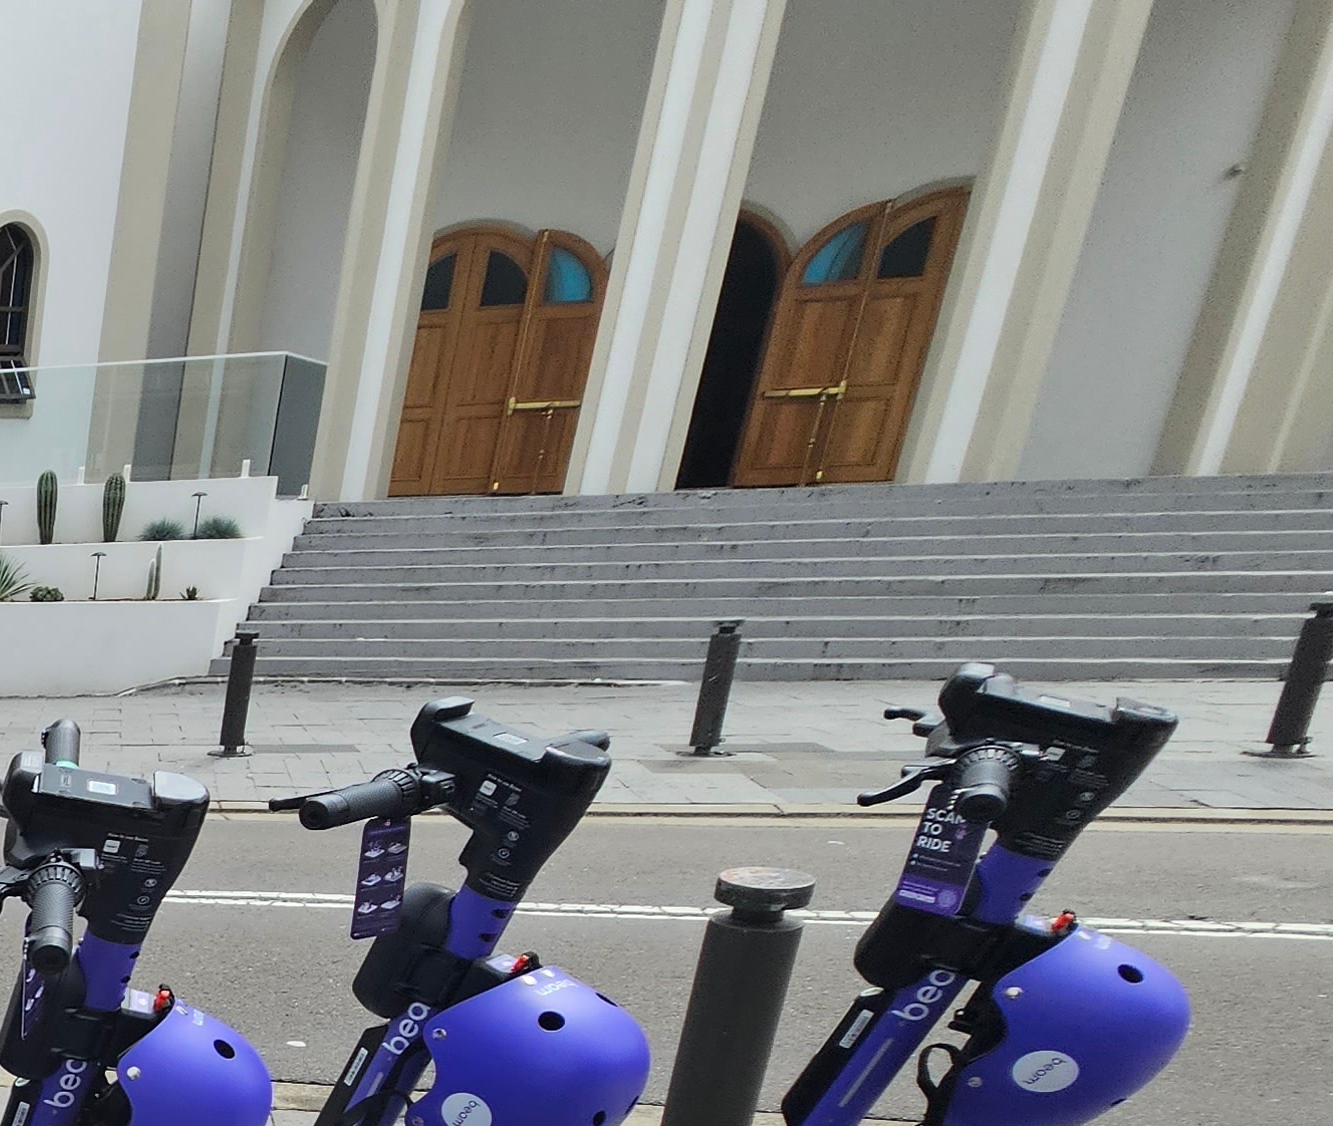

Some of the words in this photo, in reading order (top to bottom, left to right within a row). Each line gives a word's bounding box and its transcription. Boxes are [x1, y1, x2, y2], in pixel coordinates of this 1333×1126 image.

[916, 835, 952, 853] RIDE
[923, 821, 942, 835] TO
[889, 969, 957, 1021] bea
[381, 1001, 431, 1056] bea
[43, 1058, 87, 1108] bea
[1022, 1056, 1068, 1086] beam
